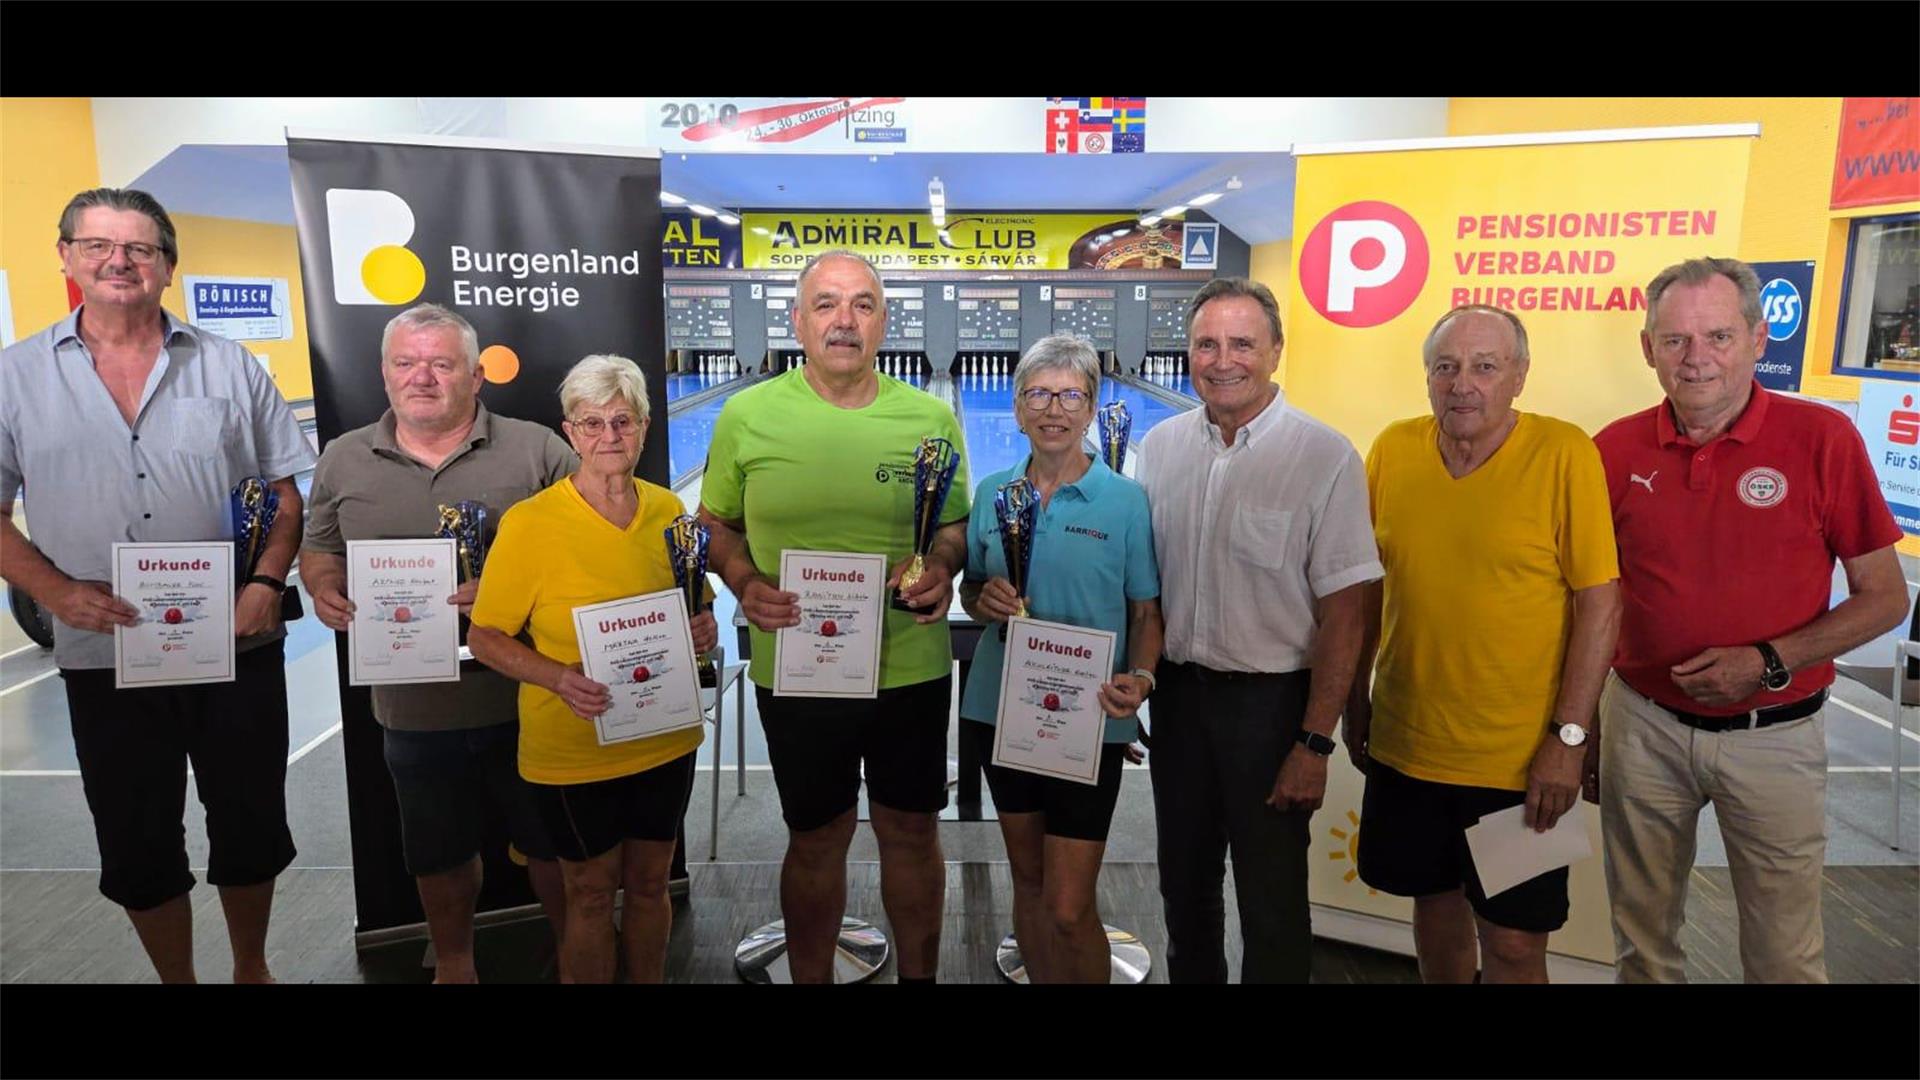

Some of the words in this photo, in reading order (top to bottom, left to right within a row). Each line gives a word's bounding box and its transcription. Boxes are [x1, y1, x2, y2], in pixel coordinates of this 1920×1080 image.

[772, 220, 934, 249] ADMIRAL
[1457, 210, 1717, 240] PENSIONISTEN
[451, 245, 639, 279] Burgenland
[662, 248, 720, 265] TEN
[770, 255, 814, 265] SOPR
[866, 255, 950, 265] UDAPEST
[965, 252, 1036, 265] SÁRVÁR
[1454, 250, 1616, 275] VERBAND
[199, 285, 268, 303] BÖNISCH
[453, 280, 580, 312] Energie
[1451, 286, 1648, 312] BURGENLAN
[1763, 294, 1798, 324] ISS
[1885, 451, 1907, 469] Für
[1886, 480, 1916, 495] Service
[1065, 525, 1109, 540] BARRIQUE
[138, 558, 211, 571] Urkunde
[370, 556, 435, 569] Urkunde
[802, 567, 865, 583] Urkunde
[599, 611, 666, 634] Urkunde
[1028, 636, 1093, 659] Urkunde
